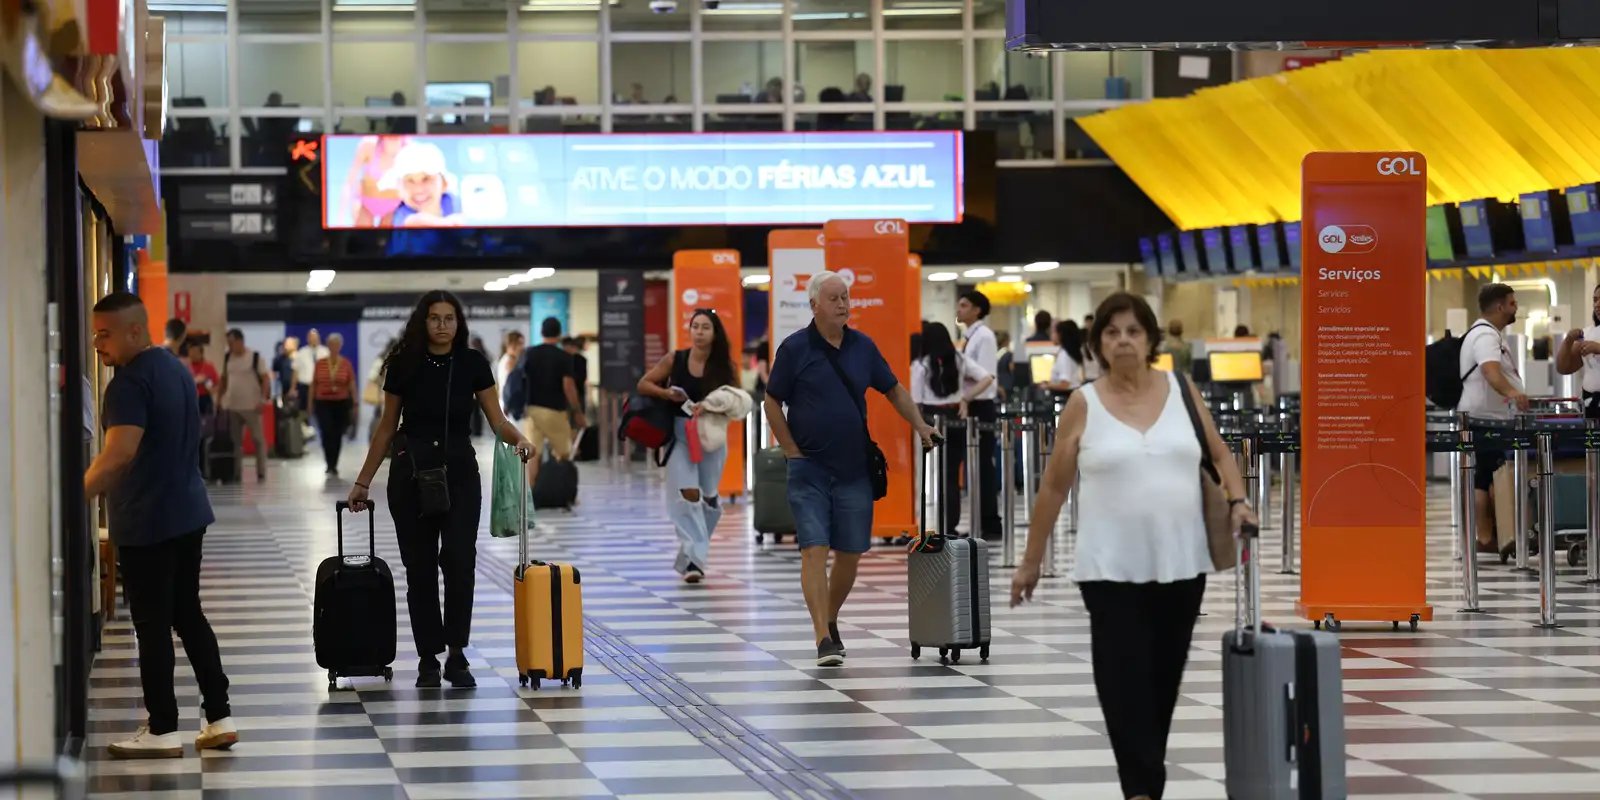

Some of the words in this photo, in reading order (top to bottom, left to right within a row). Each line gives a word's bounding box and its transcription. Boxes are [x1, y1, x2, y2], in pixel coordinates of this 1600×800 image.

[1377, 157, 1421, 176] GOL
[571, 166, 638, 193] ATIVE
[643, 166, 666, 192] O
[670, 165, 751, 192] MODO
[757, 159, 856, 190] FÉRIAS
[860, 163, 935, 189] AZUL
[874, 220, 904, 235] GOL
[1323, 234, 1343, 244] GOL
[1318, 267, 1381, 282] Serviços
[1318, 289, 1349, 298] Services
[1317, 305, 1351, 314] Servicios
